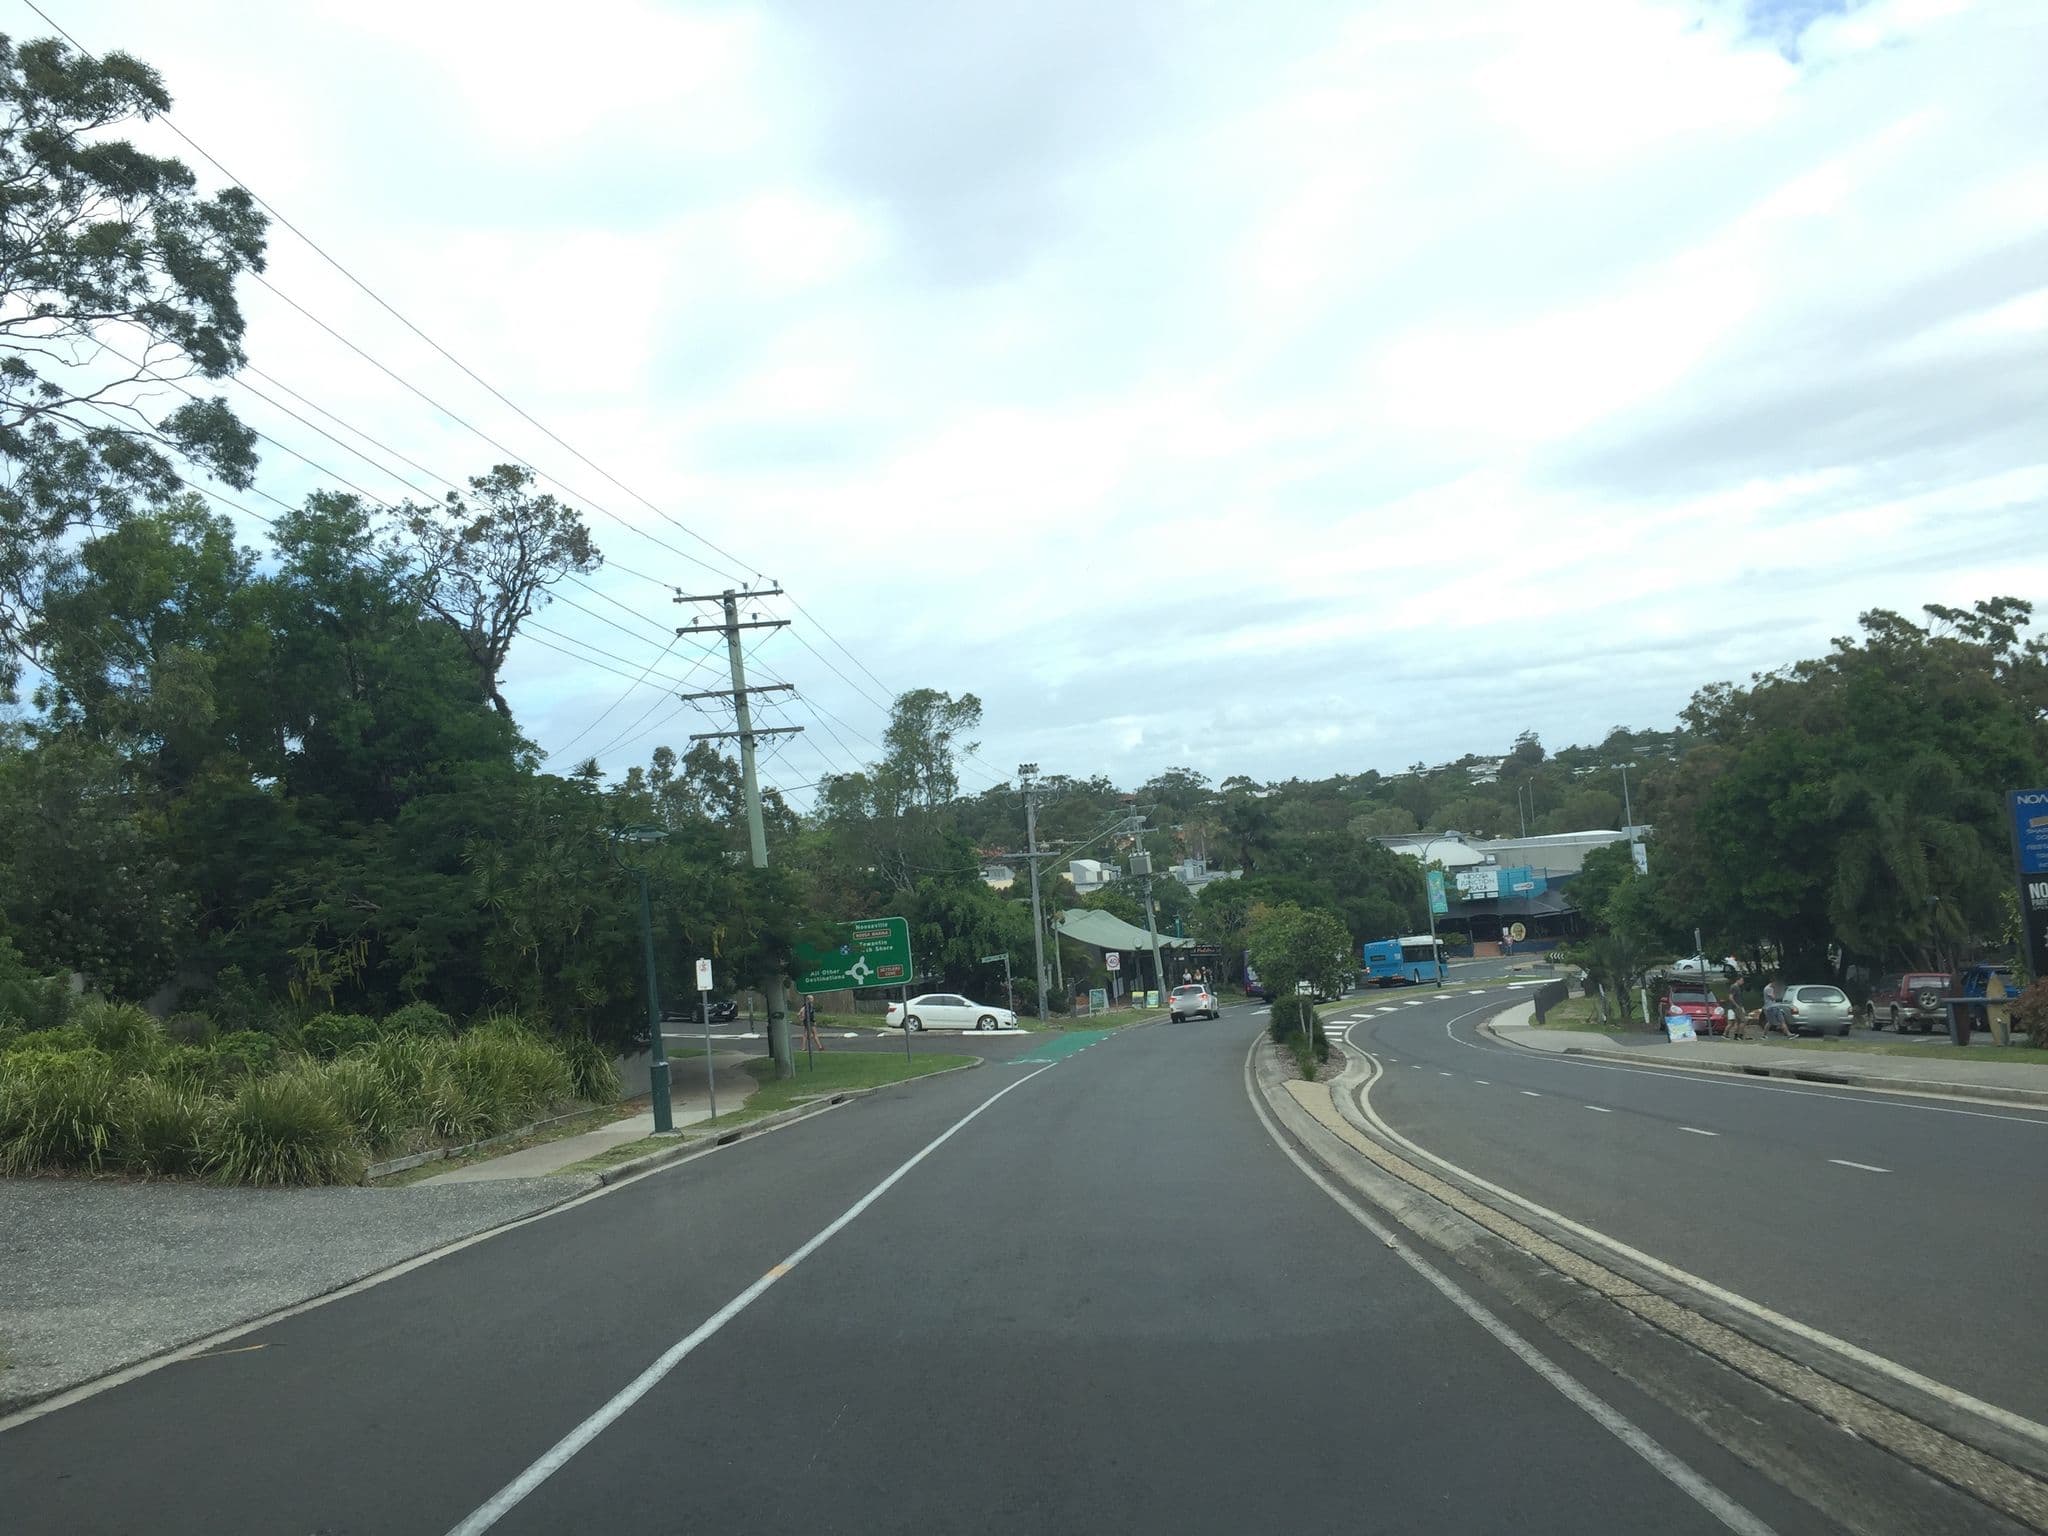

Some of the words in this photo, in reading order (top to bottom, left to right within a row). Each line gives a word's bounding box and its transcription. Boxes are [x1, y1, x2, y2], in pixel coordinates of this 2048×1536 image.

[855, 922, 888, 930] Noosaville
[810, 970, 820, 978] All
[821, 968, 840, 976] Other
[805, 974, 845, 983] Destinations
